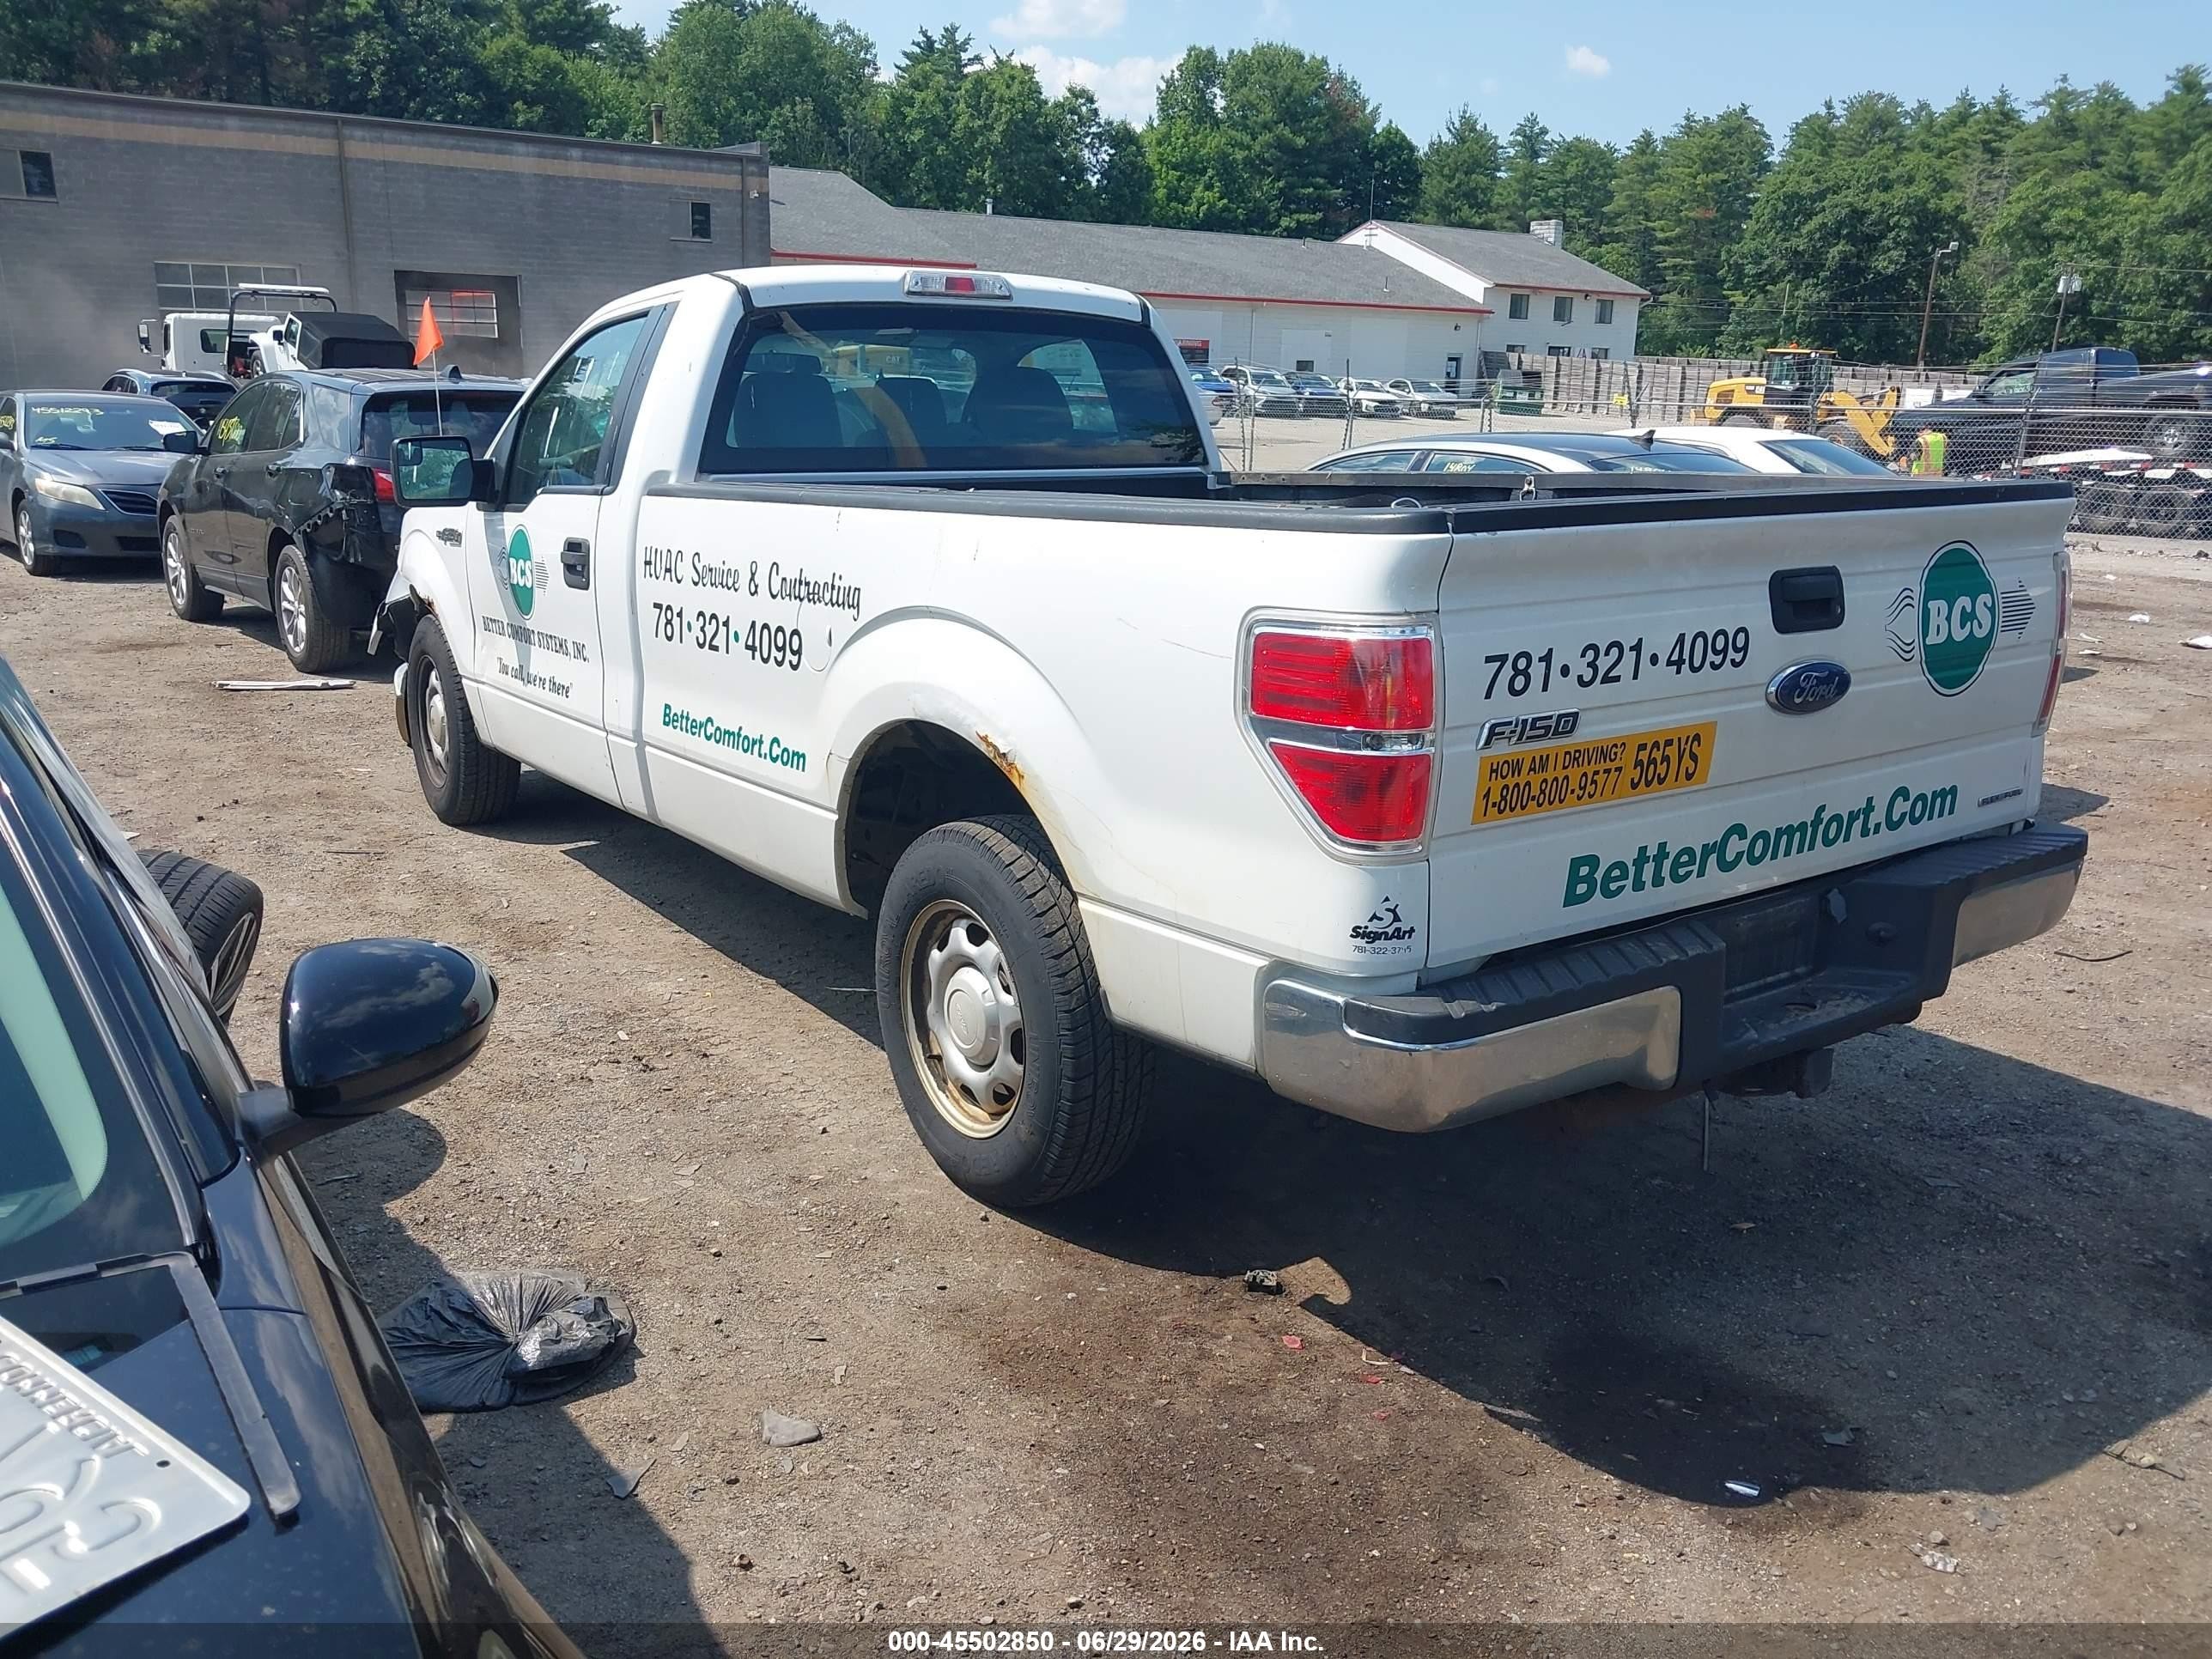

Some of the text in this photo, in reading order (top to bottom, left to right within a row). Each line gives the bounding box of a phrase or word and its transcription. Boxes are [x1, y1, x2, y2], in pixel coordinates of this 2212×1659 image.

[509, 557, 532, 588] BCS
[691, 551, 740, 592] Service
[748, 561, 759, 597] &
[768, 561, 861, 622] Contracting
[482, 615, 590, 663] BETTER COMFORT SYSTEMS, INC.
[1925, 593, 1992, 645] BCS
[511, 665, 526, 685] call,
[526, 672, 547, 690] we're
[1794, 670, 1838, 704] Ford
[662, 703, 807, 772] BetterComfort.Com
[1476, 708, 1581, 751] F-150
[1488, 742, 1627, 781] HOW AM I DRIVING?
[1630, 732, 1702, 791] 565YS
[1481, 766, 1625, 817] 1-800-800-9577
[1562, 784, 1960, 908] BetterComfort.Com
